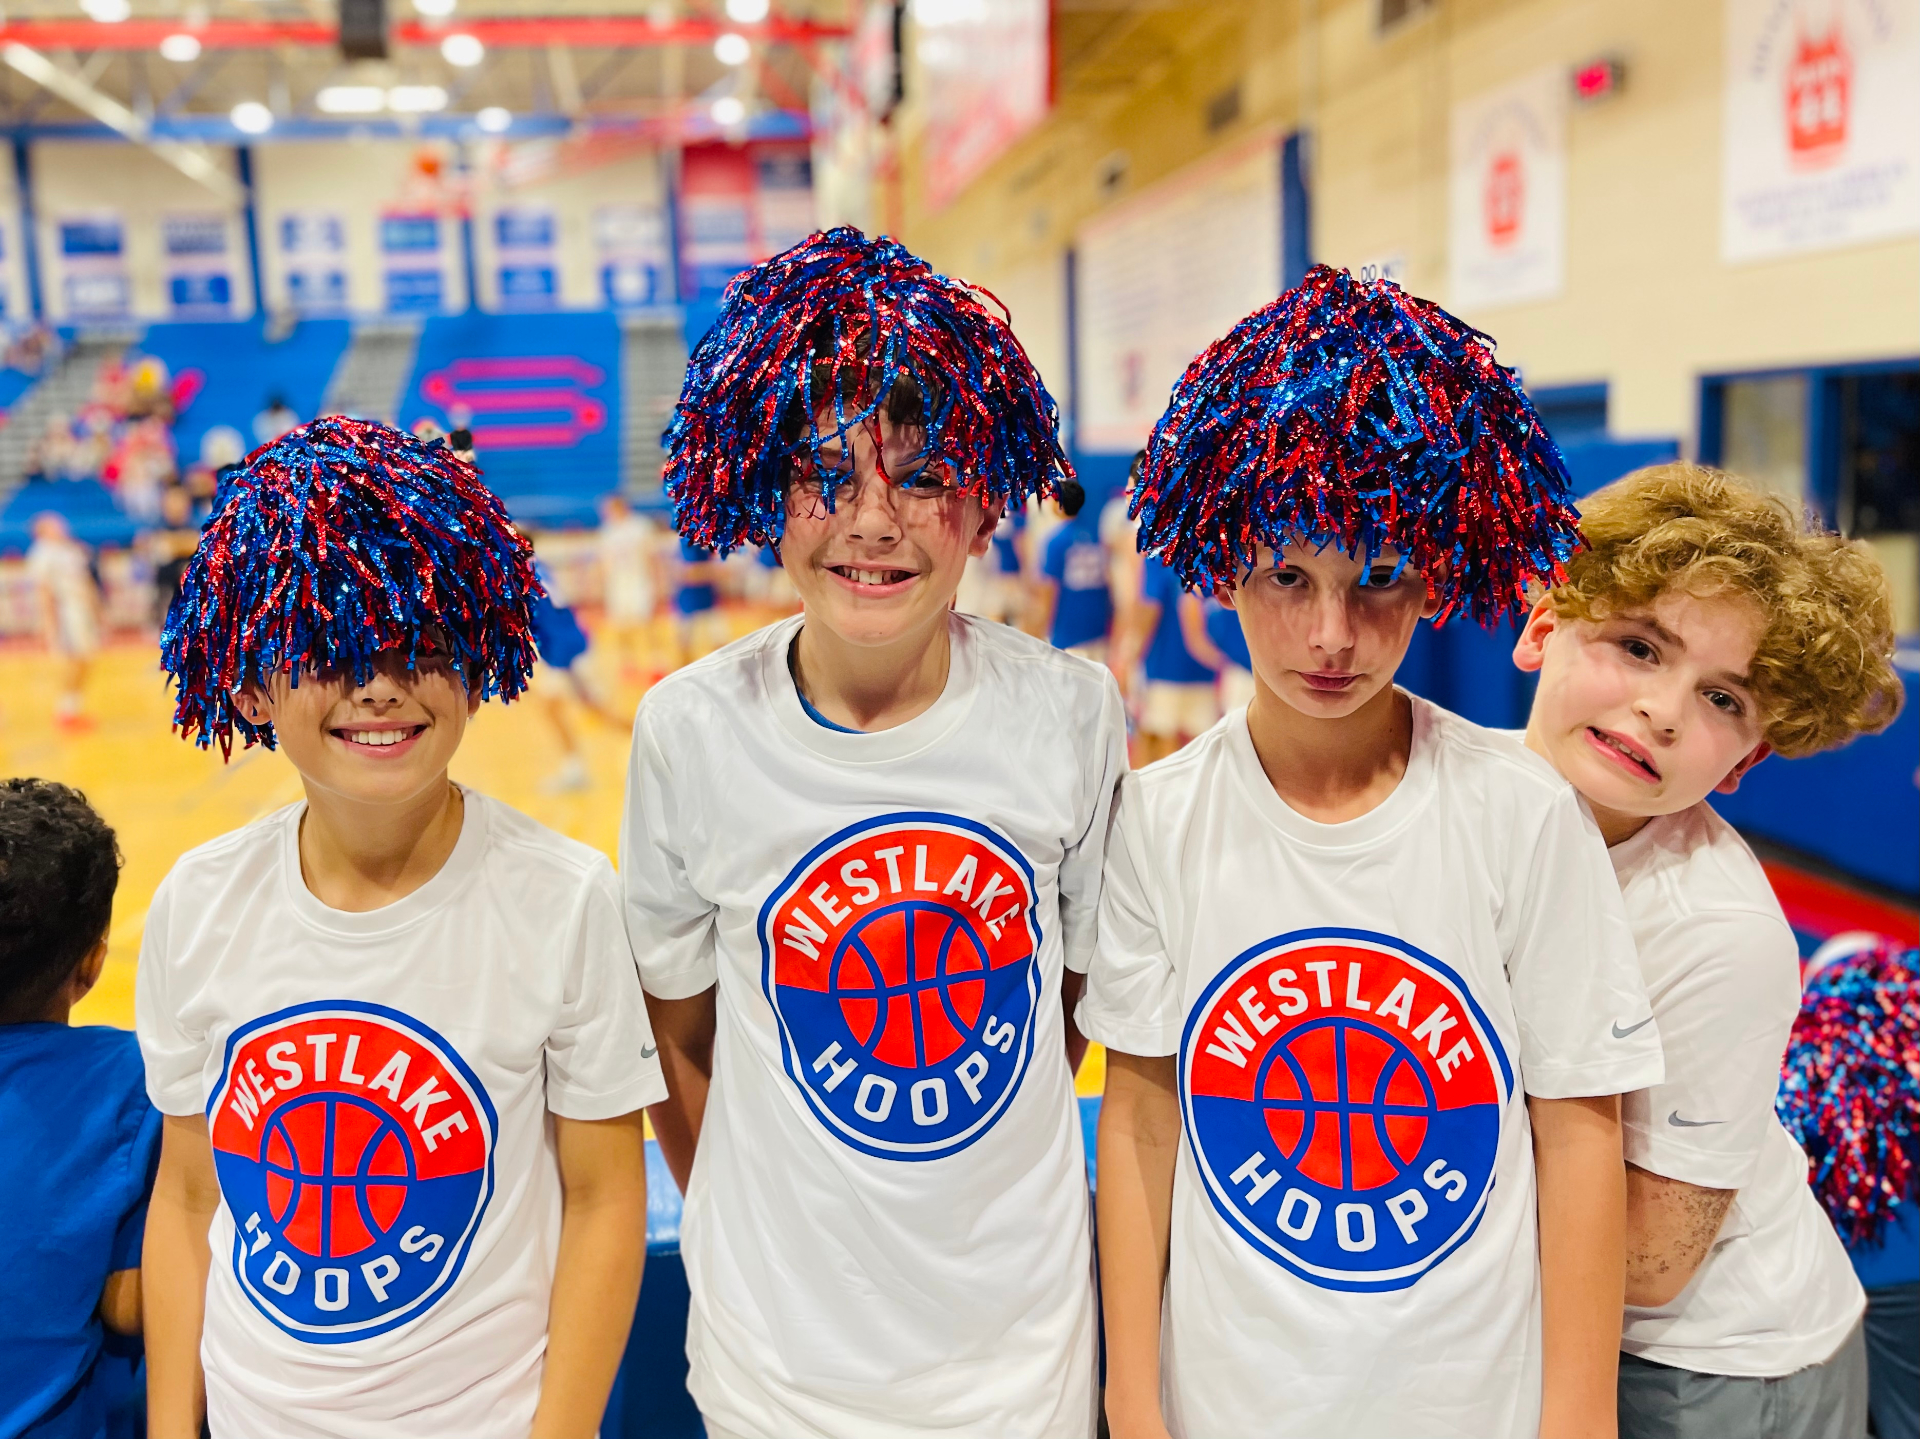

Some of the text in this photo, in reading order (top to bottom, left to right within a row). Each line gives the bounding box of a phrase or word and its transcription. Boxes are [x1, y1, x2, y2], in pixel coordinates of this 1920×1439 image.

[783, 844, 1020, 961] WESTLAKE
[812, 1014, 1016, 1126] HOOPS
[1205, 961, 1475, 1082] WESTLAKE
[230, 1033, 469, 1153] WESTLAKE
[1229, 1151, 1468, 1252] HOOPS
[245, 1211, 445, 1311] HOOPS
